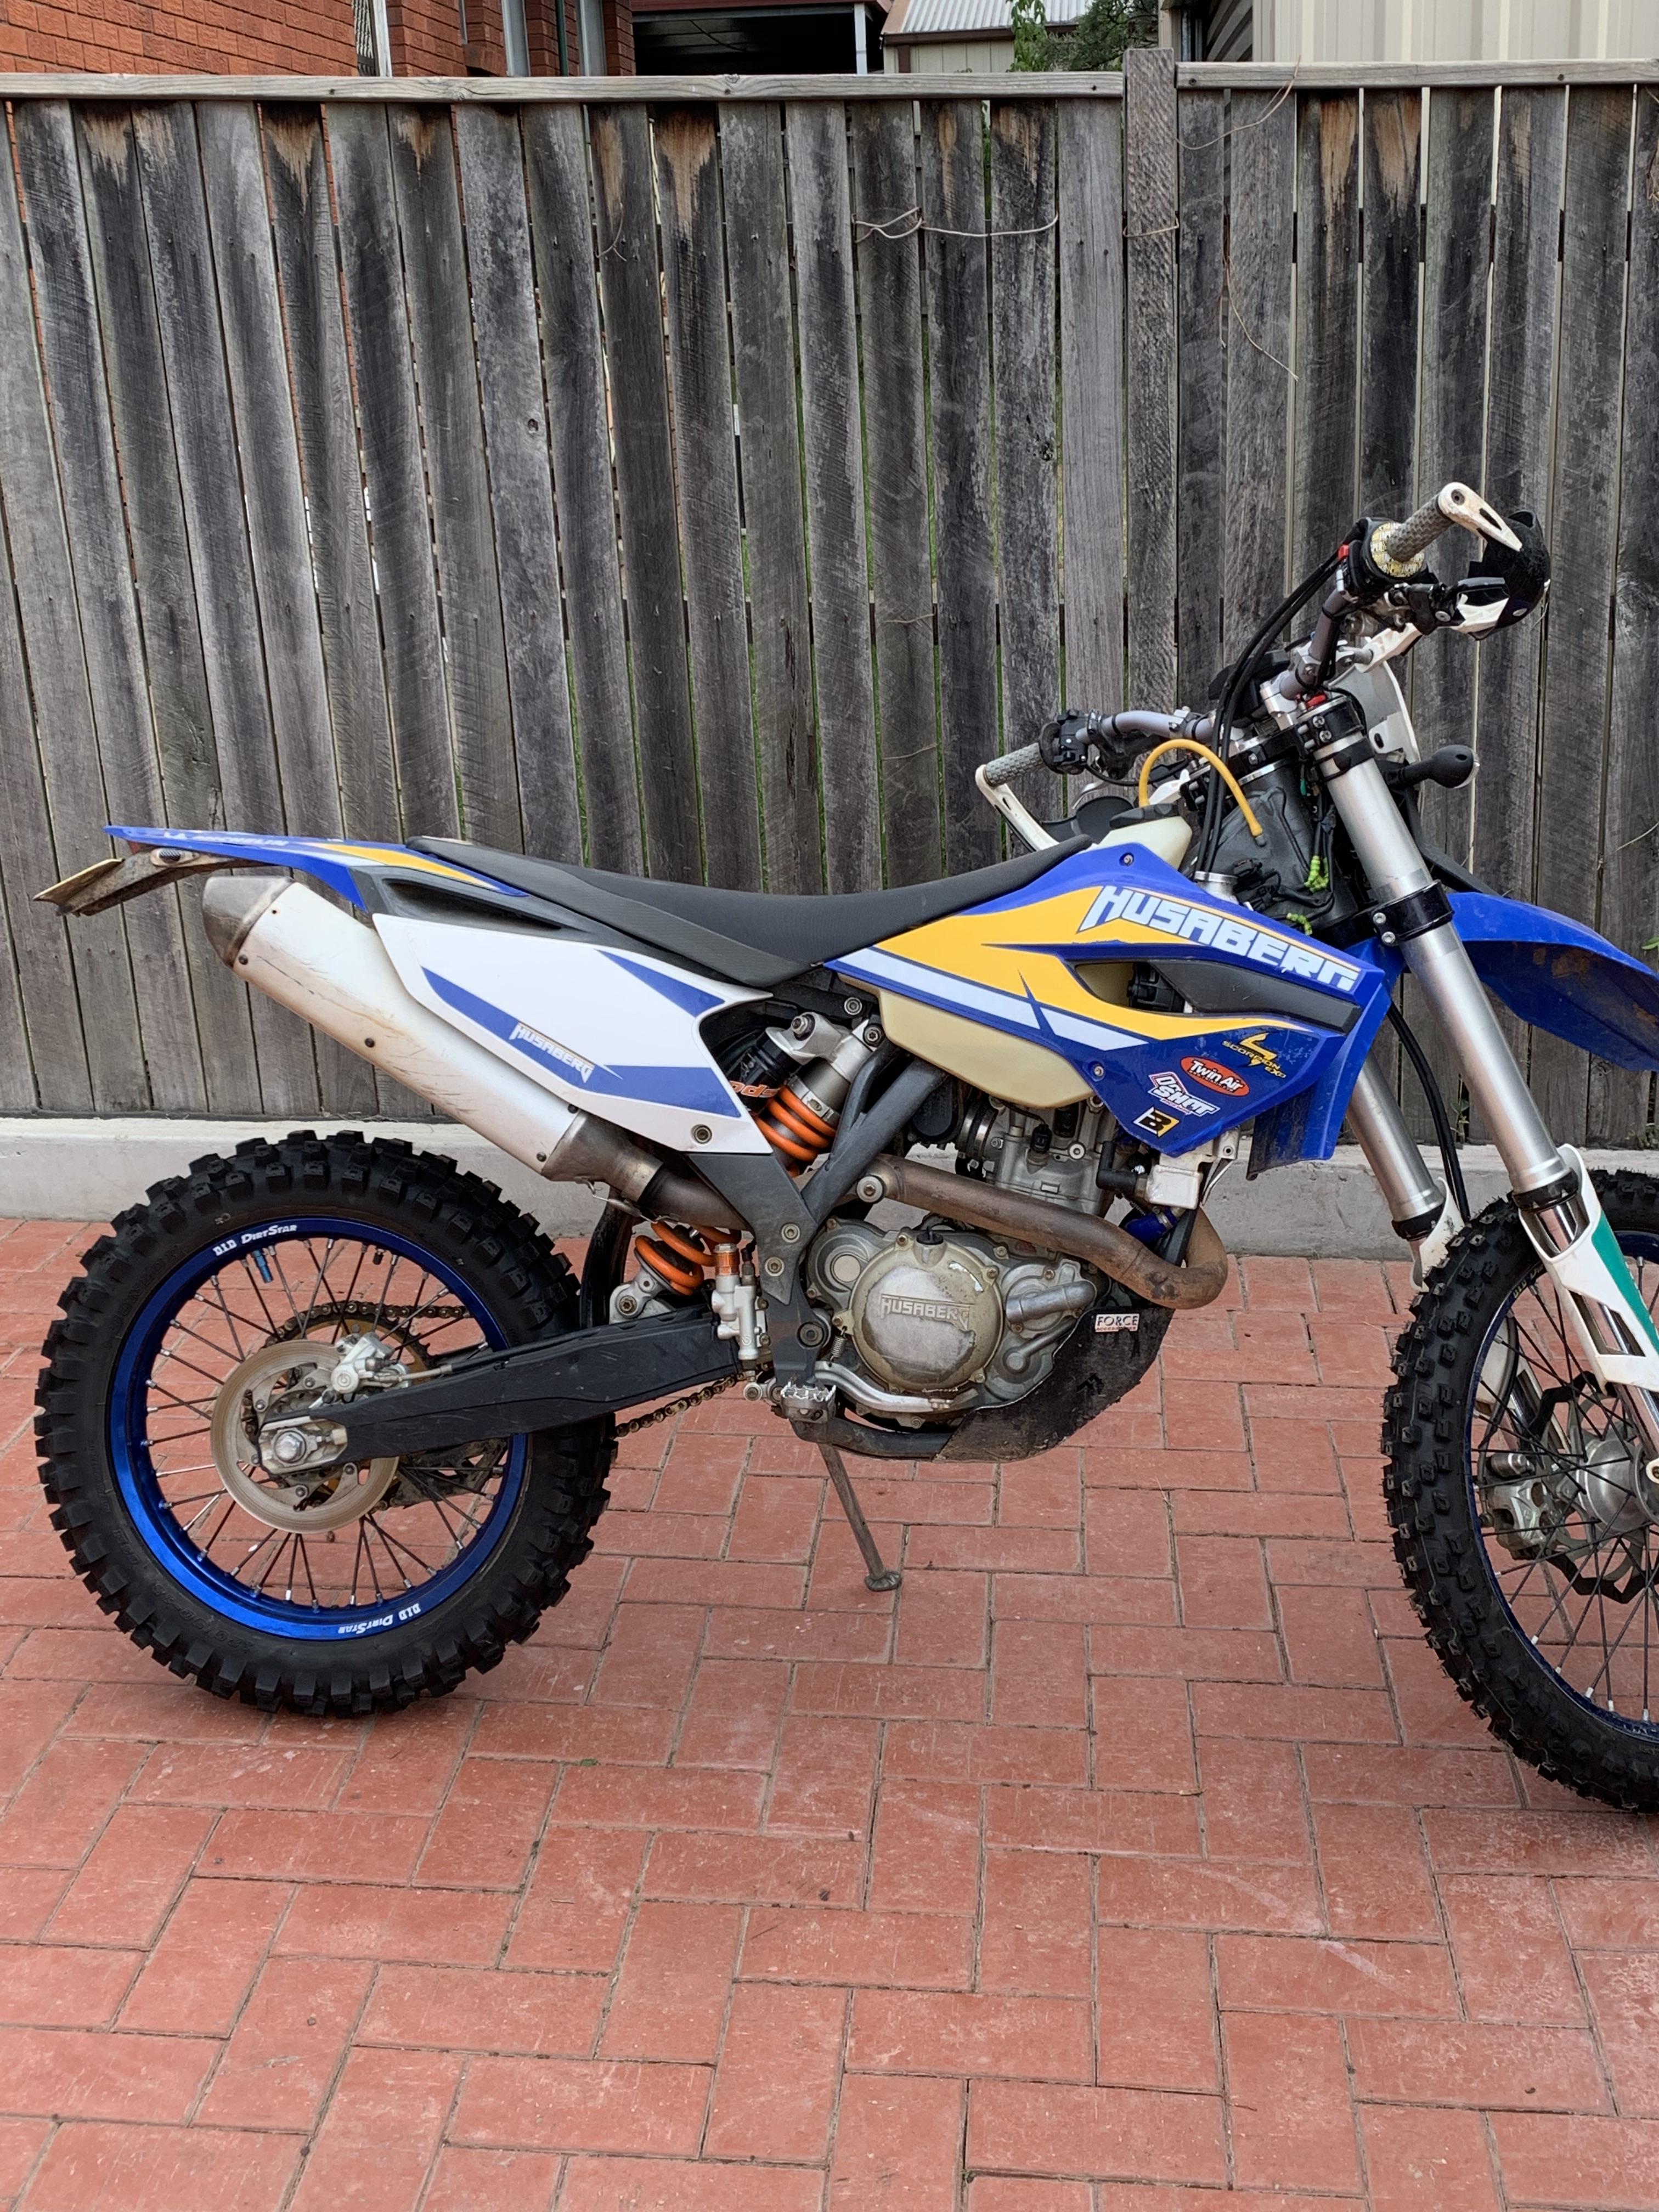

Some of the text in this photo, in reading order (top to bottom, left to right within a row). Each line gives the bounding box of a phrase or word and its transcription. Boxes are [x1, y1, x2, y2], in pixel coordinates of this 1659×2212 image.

[1078, 884, 1361, 992] HUSABERG
[509, 1023, 595, 1084] HUSABERG
[1220, 1076, 1244, 1090] Air
[881, 1296, 970, 1331] HUSABERG
[1097, 1316, 1138, 1326] FORCE
